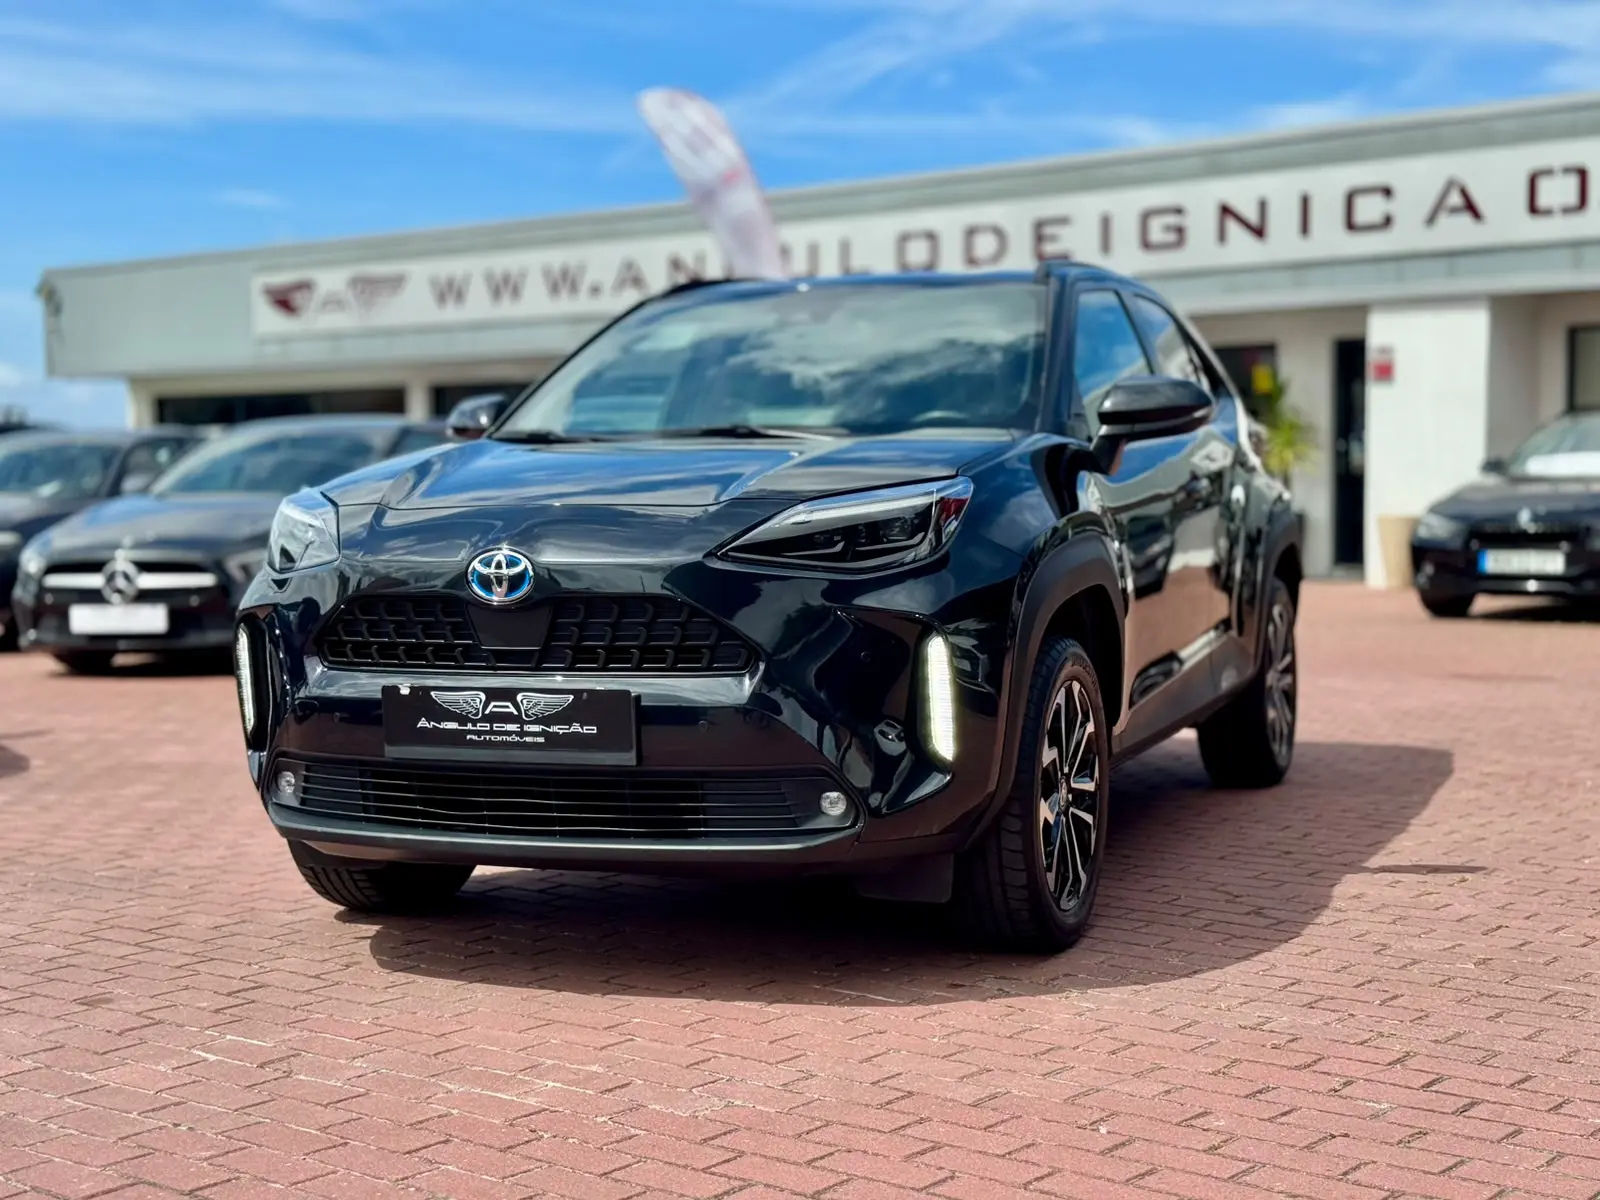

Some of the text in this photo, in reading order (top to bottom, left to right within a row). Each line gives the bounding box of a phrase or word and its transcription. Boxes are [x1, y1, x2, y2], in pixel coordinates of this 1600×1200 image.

[428, 163, 1589, 308] WWW.ANULODEIGNICAO
[485, 701, 518, 715] A
[417, 717, 597, 735] ÂNGULO DE IGNIÇÃO
[466, 734, 545, 742] AUTOMÓVEIS
